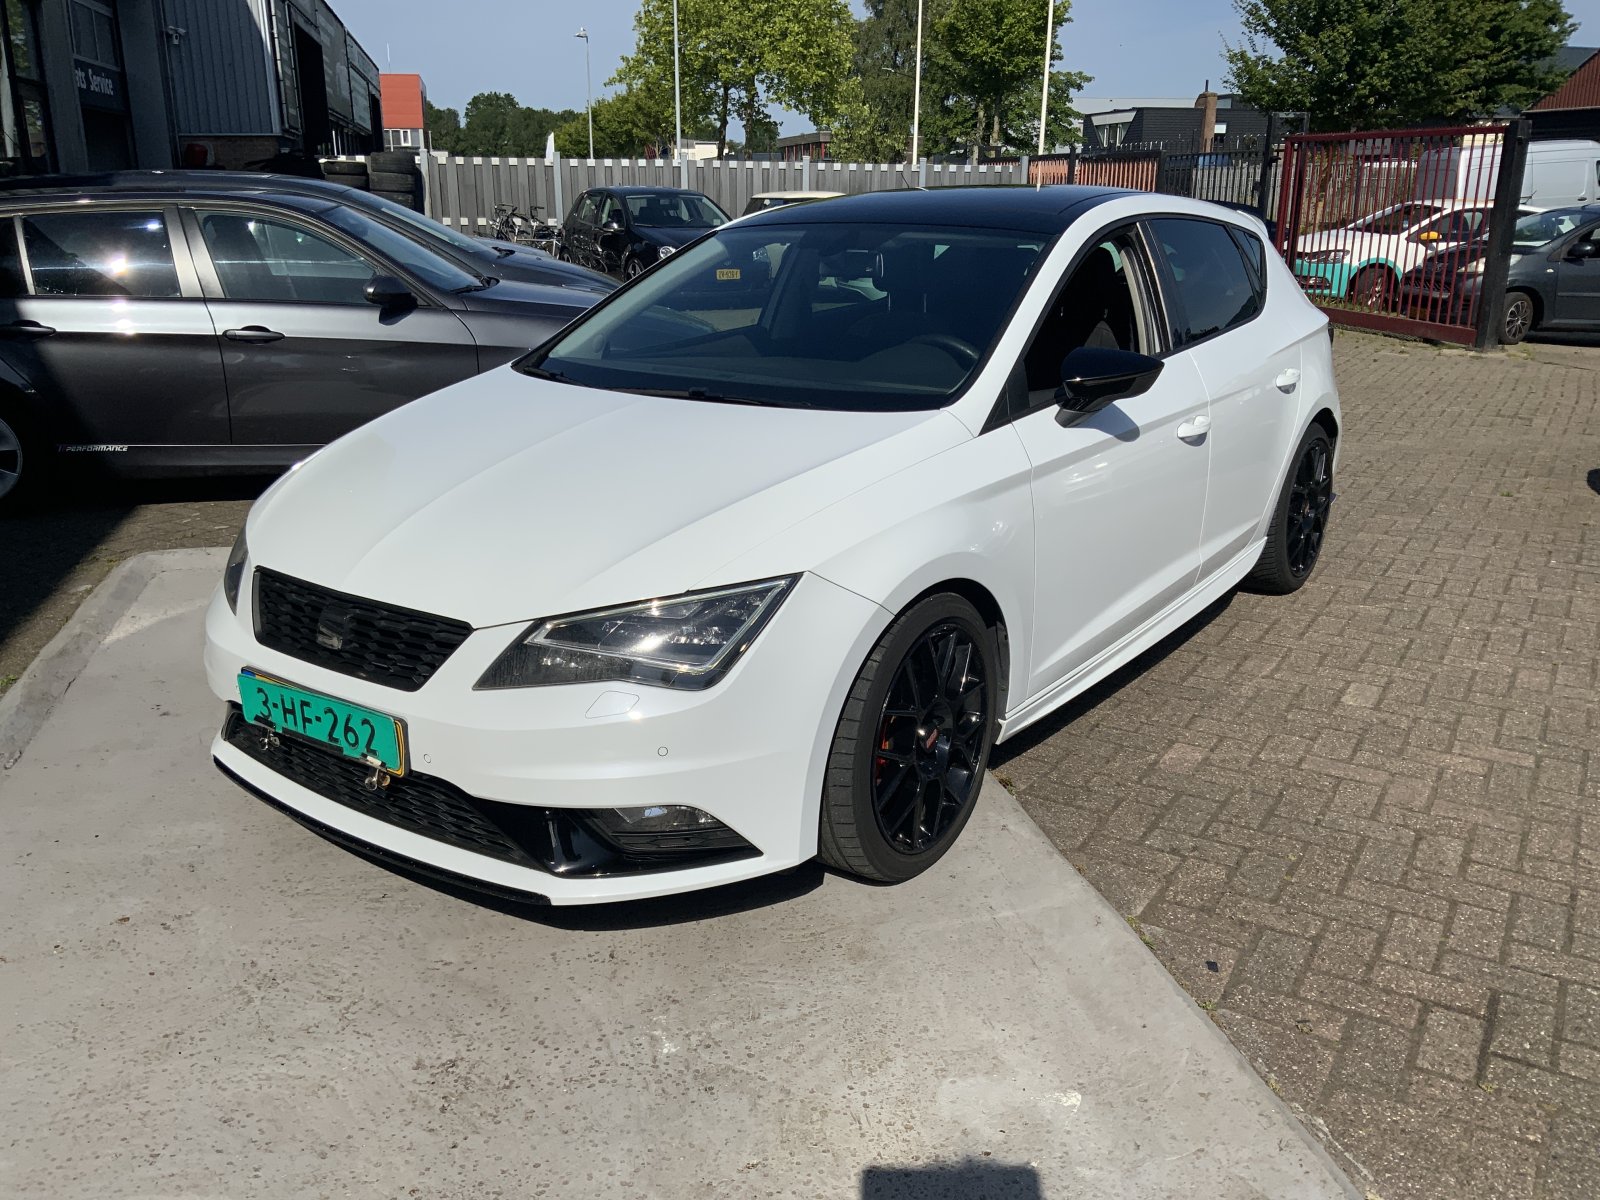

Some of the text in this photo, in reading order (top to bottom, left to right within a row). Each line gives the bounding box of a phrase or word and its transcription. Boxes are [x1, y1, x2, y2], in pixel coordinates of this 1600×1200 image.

[88, 68, 114, 95] Service
[66, 444, 128, 452] PERFORMANCE
[256, 687, 379, 757] 3-HF-262
